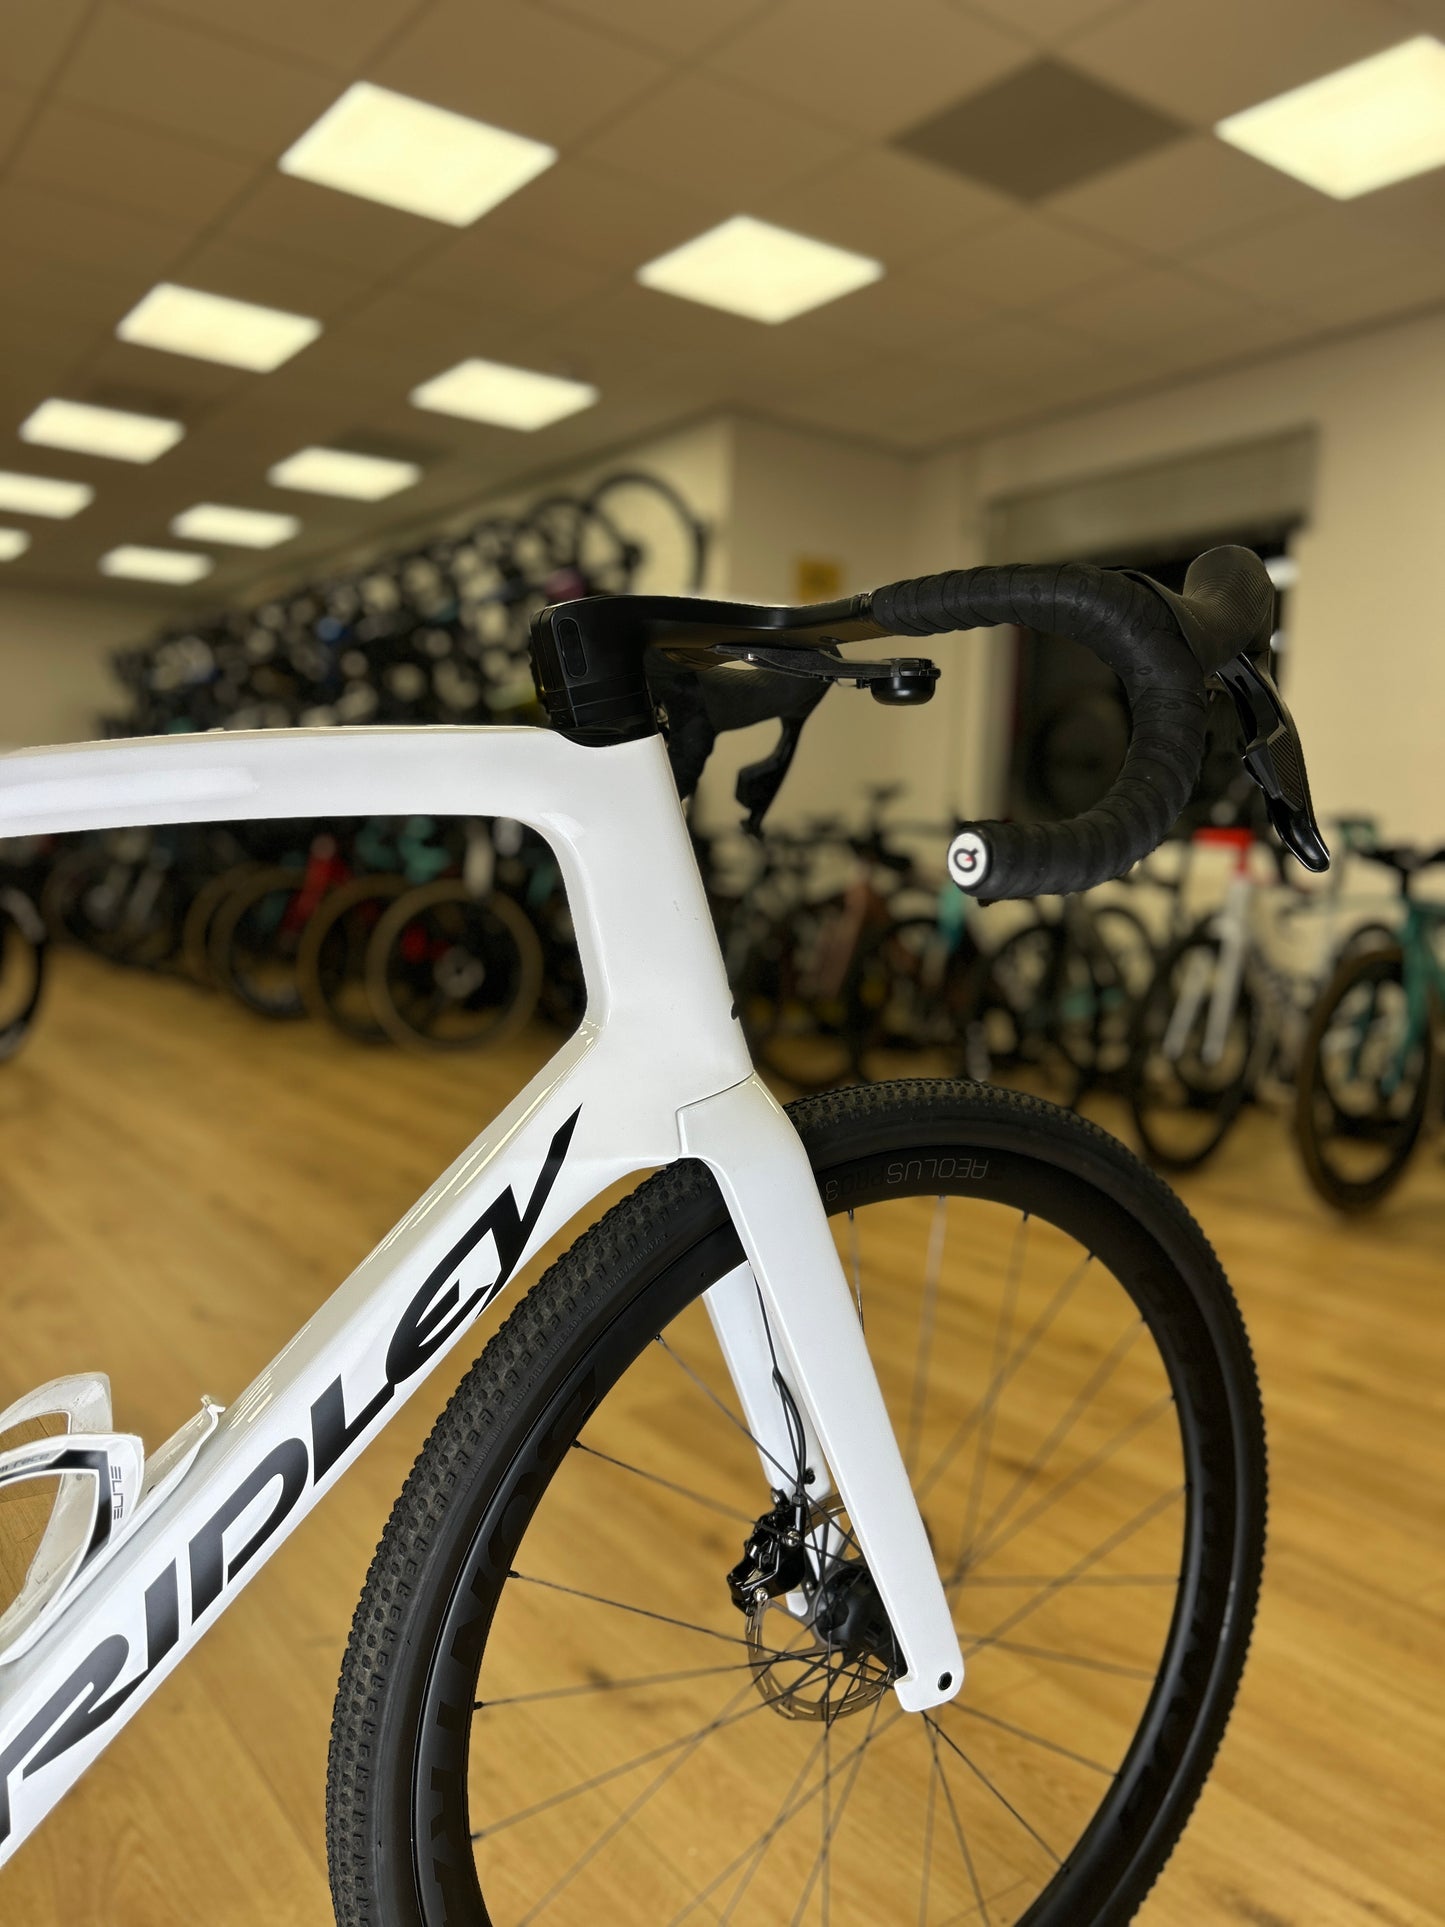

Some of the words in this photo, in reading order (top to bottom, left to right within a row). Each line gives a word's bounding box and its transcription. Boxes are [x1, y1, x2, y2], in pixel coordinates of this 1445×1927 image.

[825, 1179, 838, 1202] 3
[886, 1158, 989, 1184] AEOLUS
[0, 1103, 582, 1843] RIDLEY
[110, 1465, 124, 1520] ELITE
